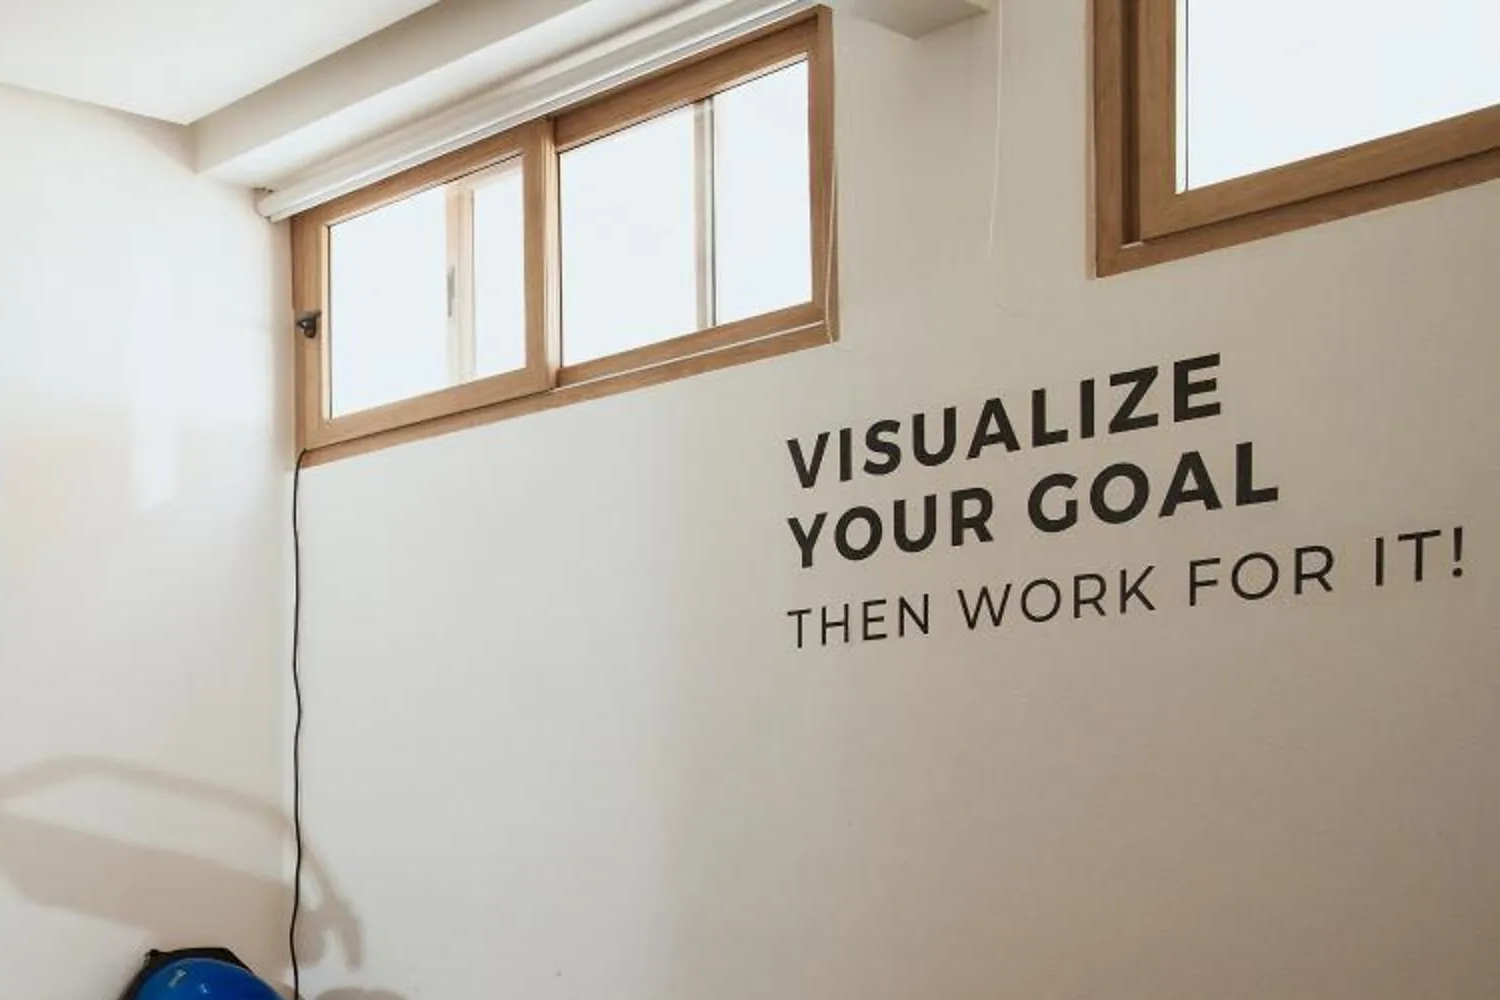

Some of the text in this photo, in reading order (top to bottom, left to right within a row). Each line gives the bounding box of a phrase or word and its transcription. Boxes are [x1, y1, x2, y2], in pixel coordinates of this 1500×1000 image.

[787, 352, 1222, 489] VISUALIZE
[787, 441, 1280, 569] YOUR GOAL
[787, 526, 1465, 649] THEN WORK FOR IT!
